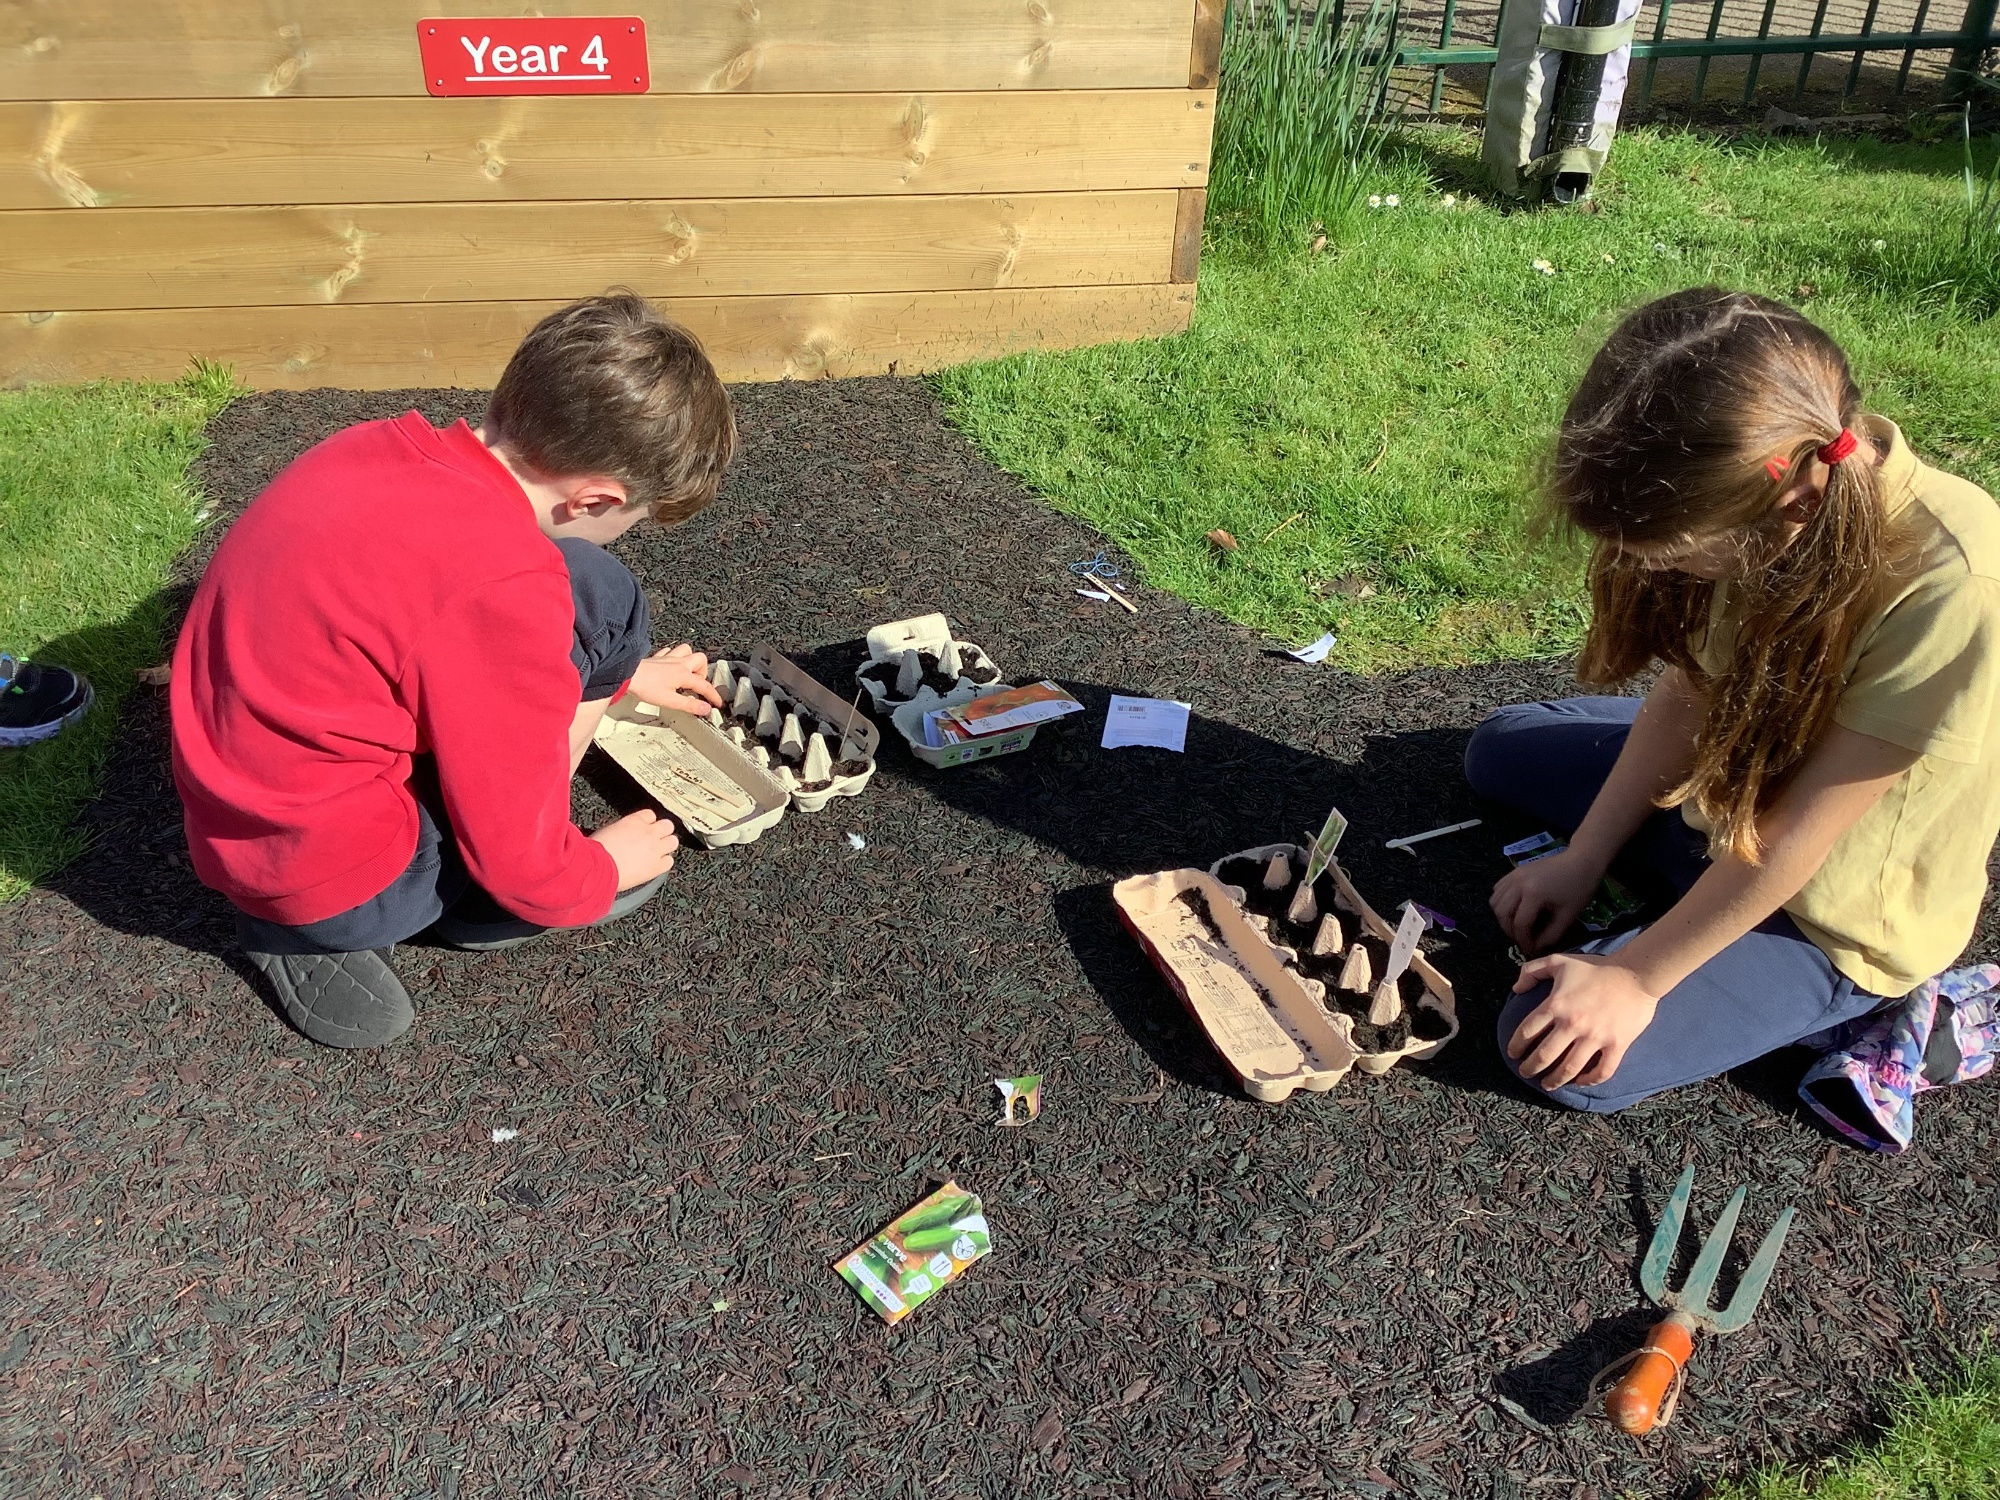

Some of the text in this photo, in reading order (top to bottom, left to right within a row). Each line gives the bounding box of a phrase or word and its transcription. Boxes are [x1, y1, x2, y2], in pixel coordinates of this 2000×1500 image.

[460, 34, 609, 75] Year 4
[868, 1240, 889, 1260] Cucumber
[883, 1238, 908, 1263] verve
